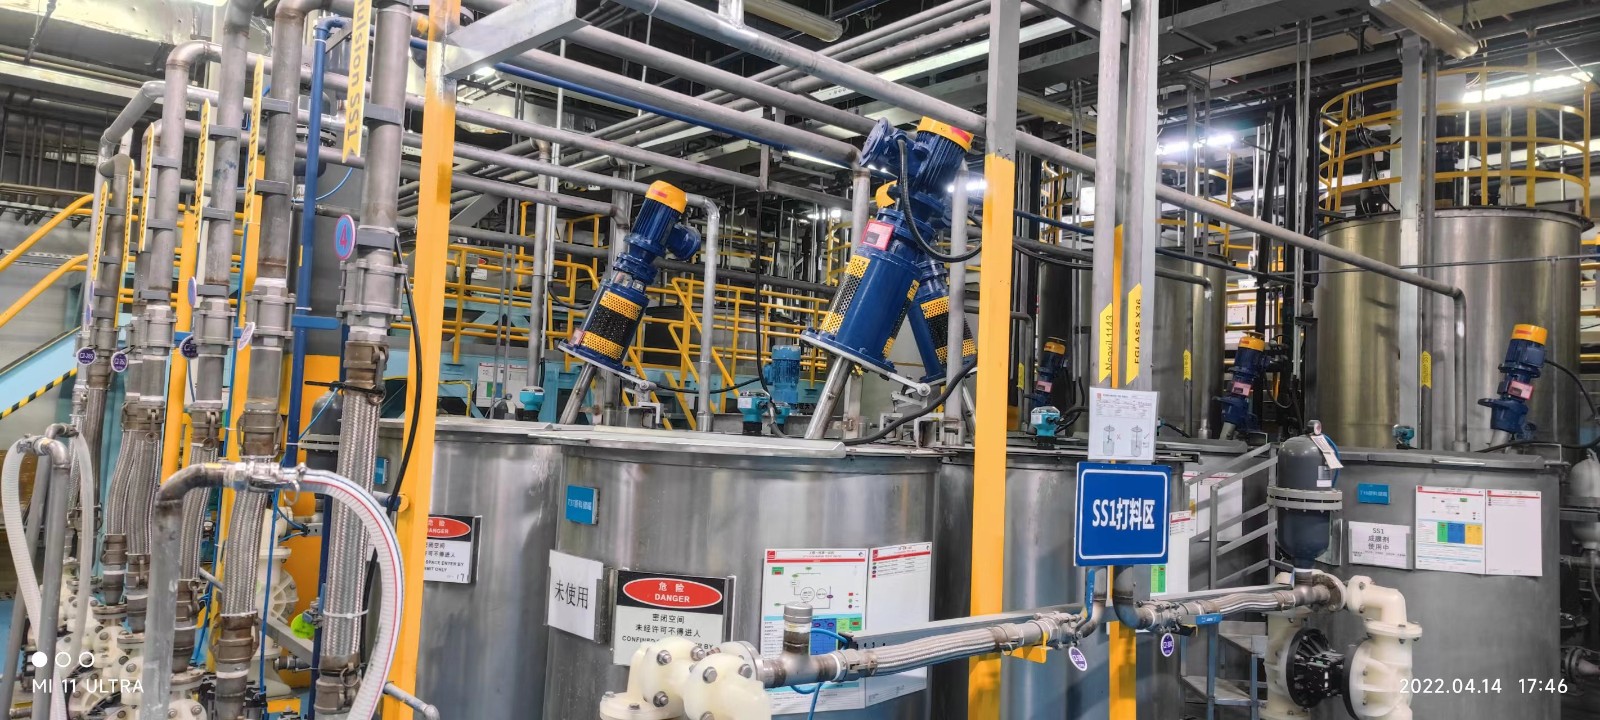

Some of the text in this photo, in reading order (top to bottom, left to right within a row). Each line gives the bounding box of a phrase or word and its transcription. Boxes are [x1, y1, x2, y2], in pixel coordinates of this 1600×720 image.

[348, 92, 360, 140] SS1
[246, 153, 255, 208] 1143
[340, 224, 348, 248] 4
[1092, 498, 1156, 530] SS1打料区
[1368, 543, 1390, 551] 使用中
[554, 580, 588, 610] 未使用
[654, 593, 690, 603] DANGER
[652, 613, 685, 624] 密闭空间
